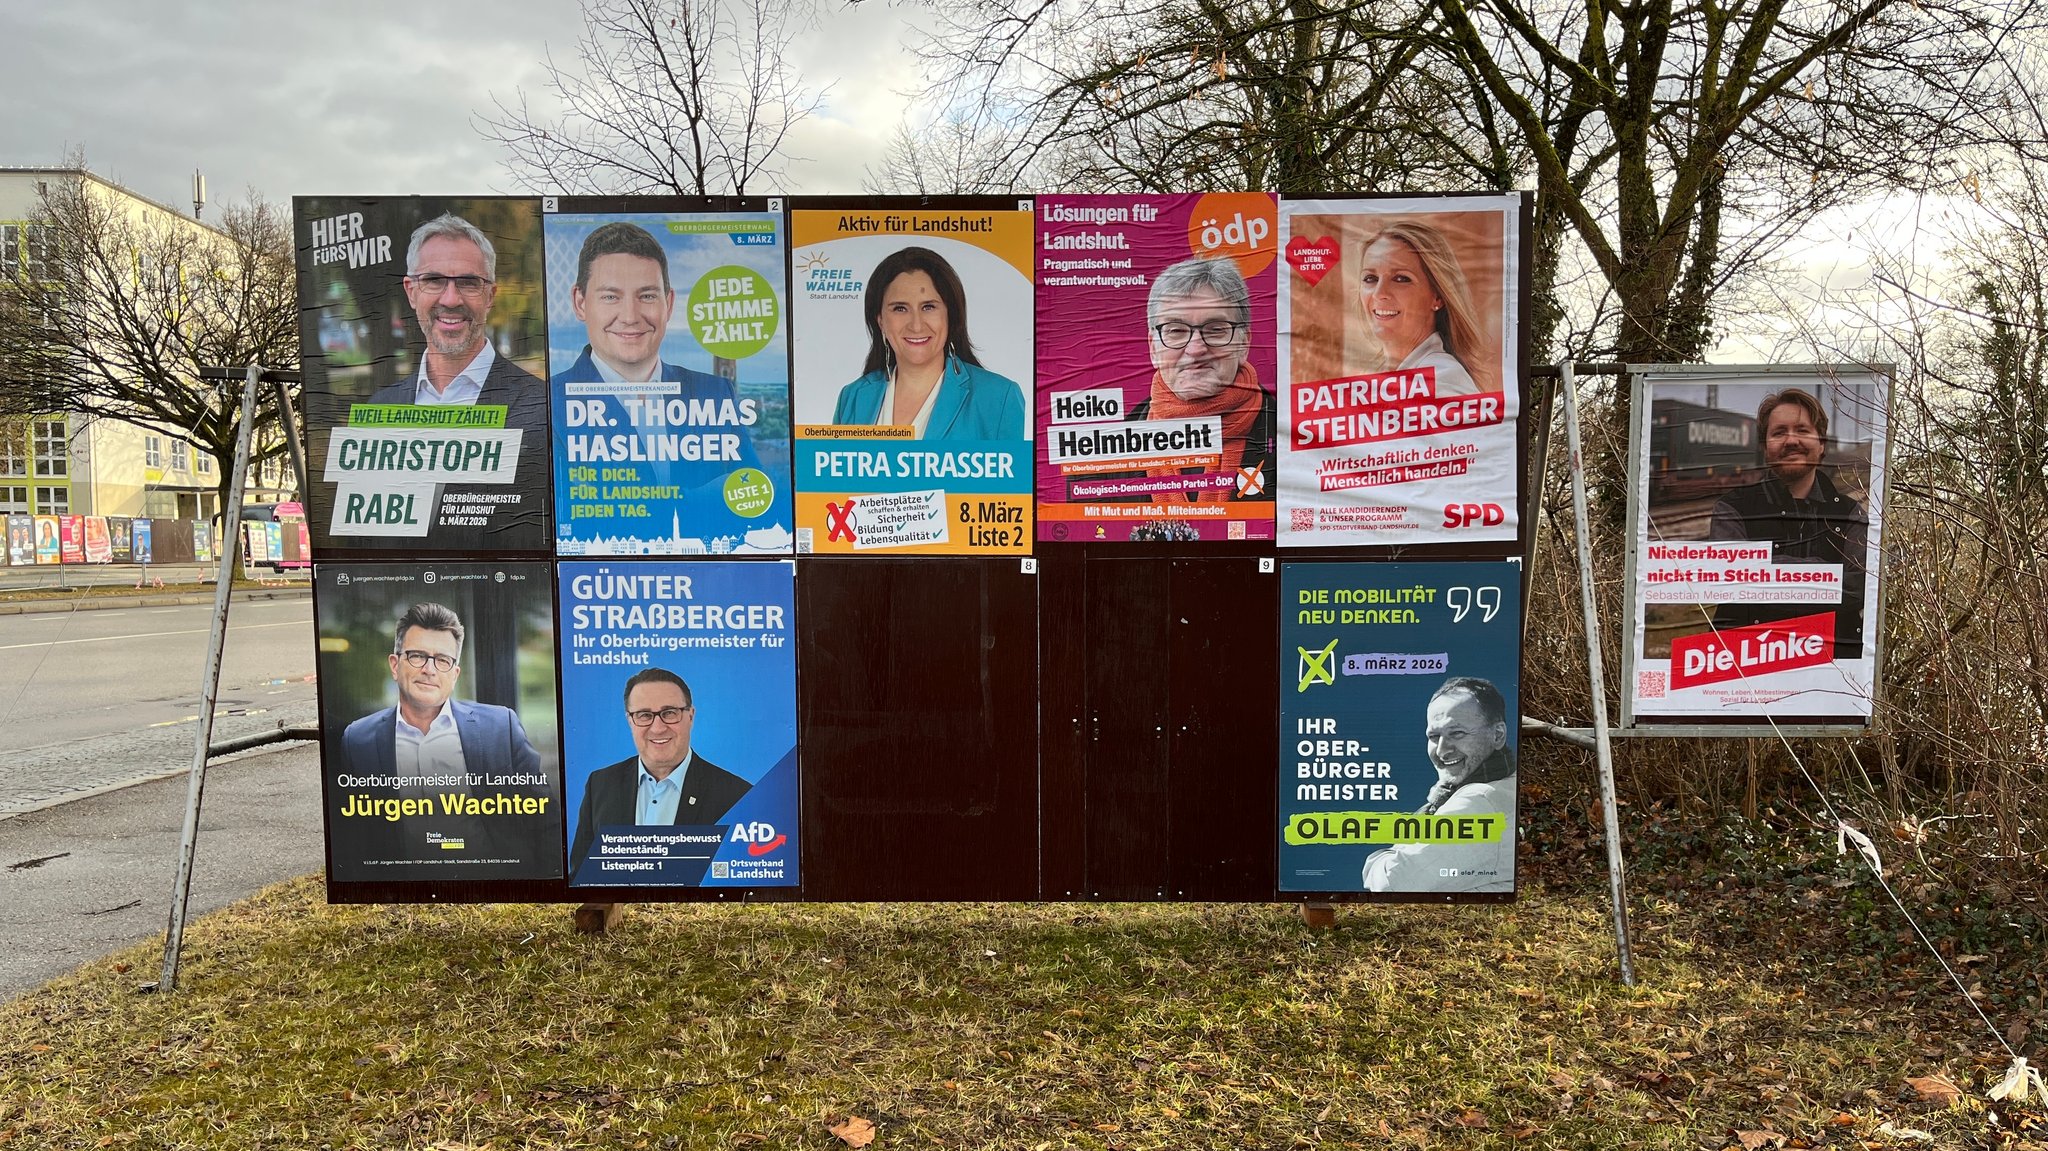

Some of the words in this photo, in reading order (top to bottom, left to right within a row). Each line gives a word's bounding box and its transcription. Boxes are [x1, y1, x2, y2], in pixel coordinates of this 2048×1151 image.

[546, 200, 554, 209] 2
[772, 202, 779, 210] 2
[1022, 203, 1029, 211] 3
[1043, 203, 1128, 225] Lösungen
[1131, 203, 1158, 222] für
[311, 212, 364, 248] HIER
[674, 223, 772, 231] OBERBÜRGERMEISTERWAHL
[838, 216, 880, 232] Aktiv
[884, 216, 909, 232] für
[912, 216, 993, 232] Landshut!
[1201, 212, 1269, 250] ödp
[737, 236, 745, 244] 8.
[747, 234, 772, 243] MÄRZ
[1043, 232, 1130, 250] Landshut.
[313, 244, 347, 266] FÜRS
[347, 235, 392, 269] WIR
[1293, 248, 1332, 256] LANDSHUT-
[1043, 258, 1110, 270] Pragmatisch
[1111, 259, 1131, 269] und
[1311, 263, 1326, 271] ROT.
[811, 269, 852, 279] FREIE
[1043, 274, 1148, 288] verantwortungsvoll.
[709, 277, 754, 300] JEDE
[806, 279, 863, 292] WÄHLER
[692, 298, 774, 321] STIMME
[702, 321, 769, 344] ZÄHLT.
[1297, 373, 1430, 413] PATRICIA
[566, 399, 617, 427] DR.
[624, 398, 758, 427] THOMAS
[1056, 395, 1119, 419] Heiko
[354, 410, 386, 425] WEIL
[387, 409, 456, 424] LANDSHUT
[457, 408, 500, 424] ZÄHLT!
[1297, 398, 1498, 445] STEINBERGER
[804, 427, 912, 439] Oberbürgermeisterkandidatin
[1058, 424, 1212, 457] Helmbrecht
[338, 438, 503, 472] CHRISTOPH
[567, 434, 742, 462] HASLINGER
[814, 451, 891, 477] PETRA
[896, 451, 1014, 479] STRASSER
[1315, 448, 1420, 476] „Wirtschaftlich
[1423, 443, 1479, 460] denken.
[568, 467, 597, 482] FÜR
[602, 468, 641, 482] DICH.
[1324, 468, 1401, 490] Menschlich
[570, 485, 597, 500] FÜR
[603, 486, 684, 500] LANDSHUT.
[727, 485, 760, 502] LISTE
[761, 483, 770, 495] 1
[1073, 479, 1181, 496] Ökologisch-Demokratische
[1183, 479, 1208, 489] Partei
[1215, 475, 1234, 487] ÖDP
[443, 493, 521, 504] OBERBÜRGERMEISTER
[859, 496, 922, 508] Arbeitsplätze
[344, 494, 418, 525] RABL
[441, 504, 455, 514] FÜR
[456, 505, 496, 515] LANDSHUT
[570, 505, 614, 520] JEDEN
[618, 504, 651, 517] TAG.
[867, 506, 895, 514] schaffen
[902, 504, 930, 512] erhalten
[959, 502, 976, 523] 8.
[978, 502, 1023, 523] März
[1084, 506, 1100, 517] Mit
[1101, 506, 1120, 517] Mut
[1122, 506, 1140, 516] und
[1142, 505, 1166, 516] Maß.
[1167, 505, 1226, 516] Miteinander.
[1319, 507, 1337, 515] ALLE
[1338, 506, 1408, 514] KANDIDIERENDEN
[1442, 503, 1505, 529] SPD
[439, 517, 447, 526] 8.
[447, 515, 468, 526] MÄRZ
[469, 517, 488, 526] 2026
[877, 512, 926, 524] Sicherheit
[857, 524, 894, 535] Bildung
[860, 531, 931, 545] Lebensqualität
[968, 525, 1009, 546] Liste
[1013, 526, 1023, 546] 2
[1647, 545, 1768, 563] Niederbayern
[1024, 561, 1032, 570] 8
[1263, 561, 1270, 570] 9
[571, 568, 693, 600] GÜNTER
[1647, 568, 1693, 583] nicht
[1697, 568, 1720, 583] im
[1724, 568, 1771, 583] Stich
[1775, 568, 1839, 583] lassen.
[1298, 589, 1329, 604] DIE
[1334, 585, 1437, 604] MOBILITÄT
[1645, 590, 1700, 601] Sebastian
[1703, 590, 1734, 602] Meier,
[1738, 589, 1840, 601] Stadtratskandidat
[572, 603, 785, 630] STRAßBERGER
[1298, 609, 1335, 625] NEU
[1341, 609, 1420, 624] DENKEN.
[573, 634, 595, 648] Ihr
[600, 633, 755, 651] Oberbürgermeister
[760, 633, 785, 648] für
[573, 651, 649, 665] Landshut
[1347, 660, 1360, 670] 8.
[1365, 656, 1406, 670] MÄRZ
[1411, 659, 1443, 670] 2026
[1684, 643, 1735, 677] Die
[1297, 718, 1337, 735] IHR
[1297, 740, 1370, 757] OBER-
[1297, 757, 1391, 779] BÜRGER
[337, 773, 463, 790] Oberbürgermeister
[465, 772, 483, 786] für
[485, 772, 547, 786] Landshut
[1297, 784, 1399, 801] MEISTER
[341, 794, 434, 822] Jürgen
[439, 793, 549, 815] Wachter
[730, 821, 776, 843] AfD
[1297, 818, 1381, 839] OLAF
[1393, 818, 1495, 839] MINET
[601, 833, 722, 845] Verantwortungsbewusst
[601, 845, 669, 856] Bodenständig
[601, 861, 655, 872] Listenplatz
[656, 861, 663, 870] 1
[730, 859, 784, 868] Ortsverband
[730, 869, 784, 879] Landshut
